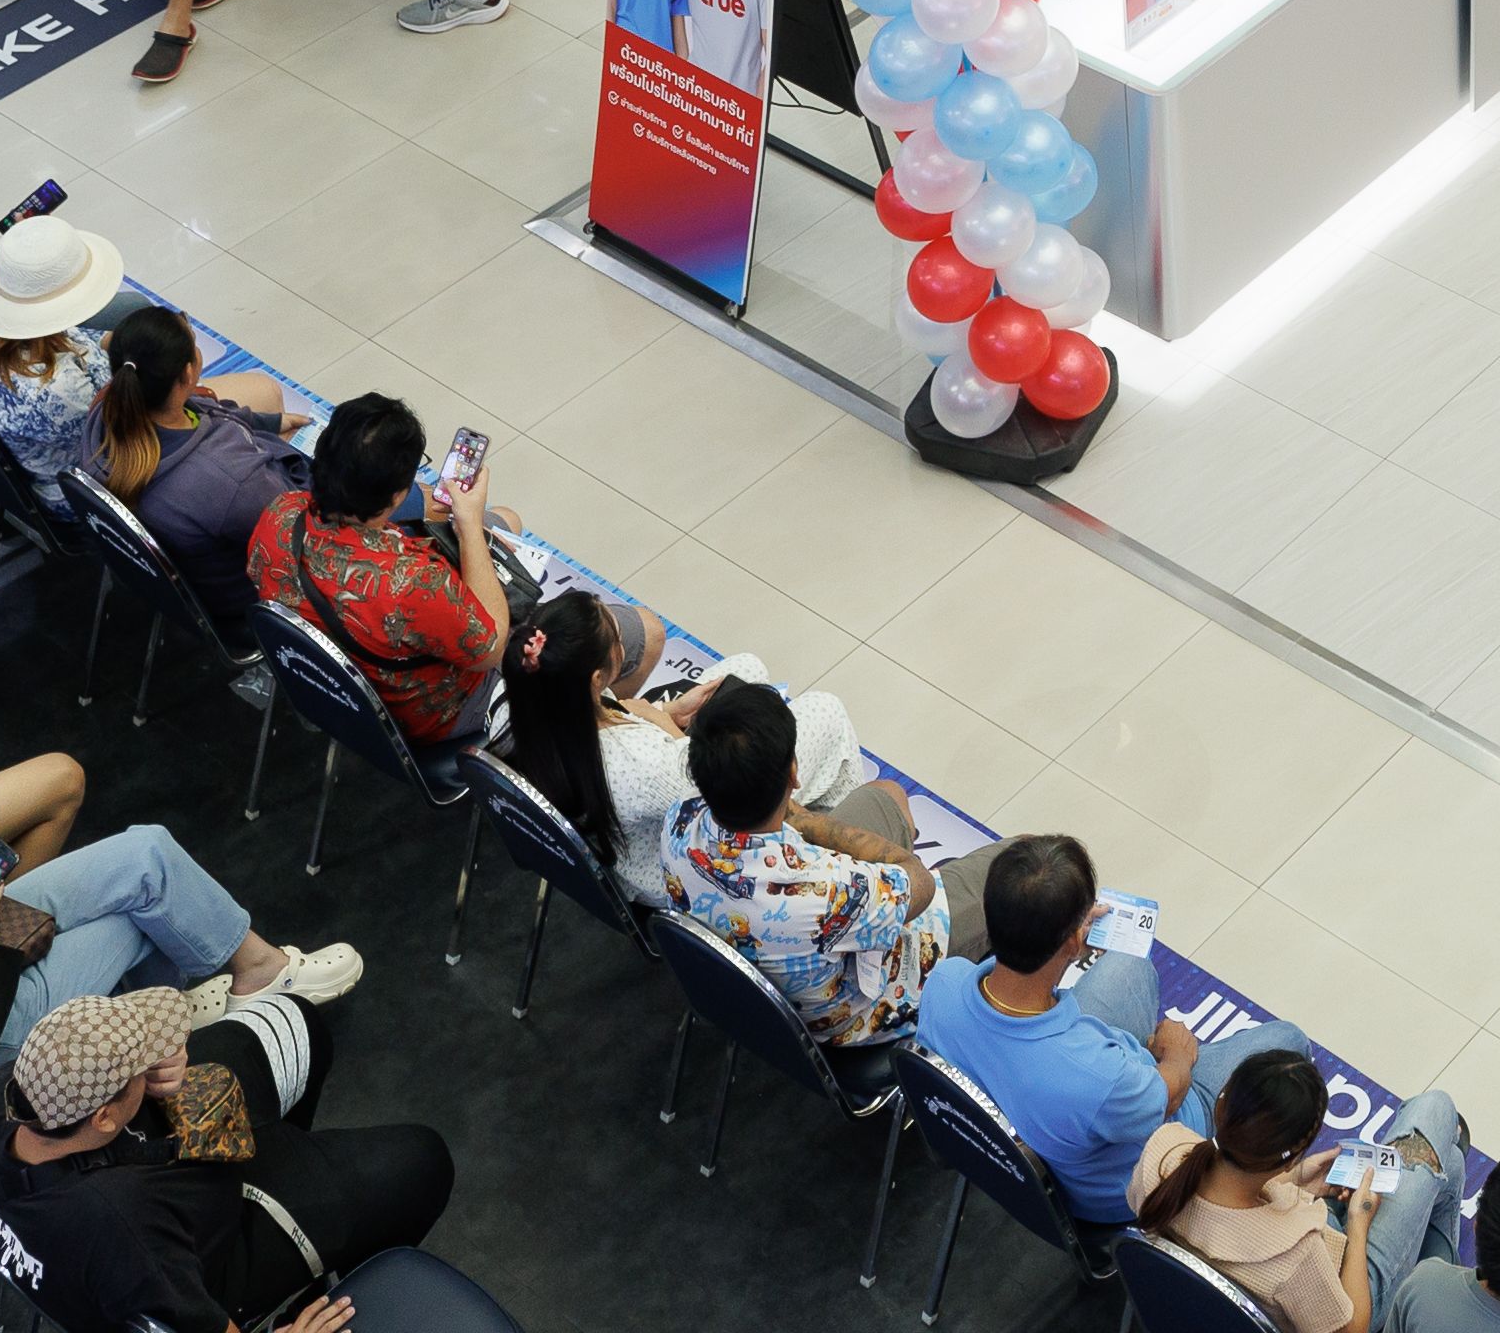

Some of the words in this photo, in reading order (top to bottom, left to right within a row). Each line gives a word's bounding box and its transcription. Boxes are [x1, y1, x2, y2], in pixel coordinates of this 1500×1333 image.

[620, 43, 746, 122] ด้วยบริการที่ครบครัน
[1137, 914, 1154, 930] 20
[1380, 1151, 1396, 1168] 21
